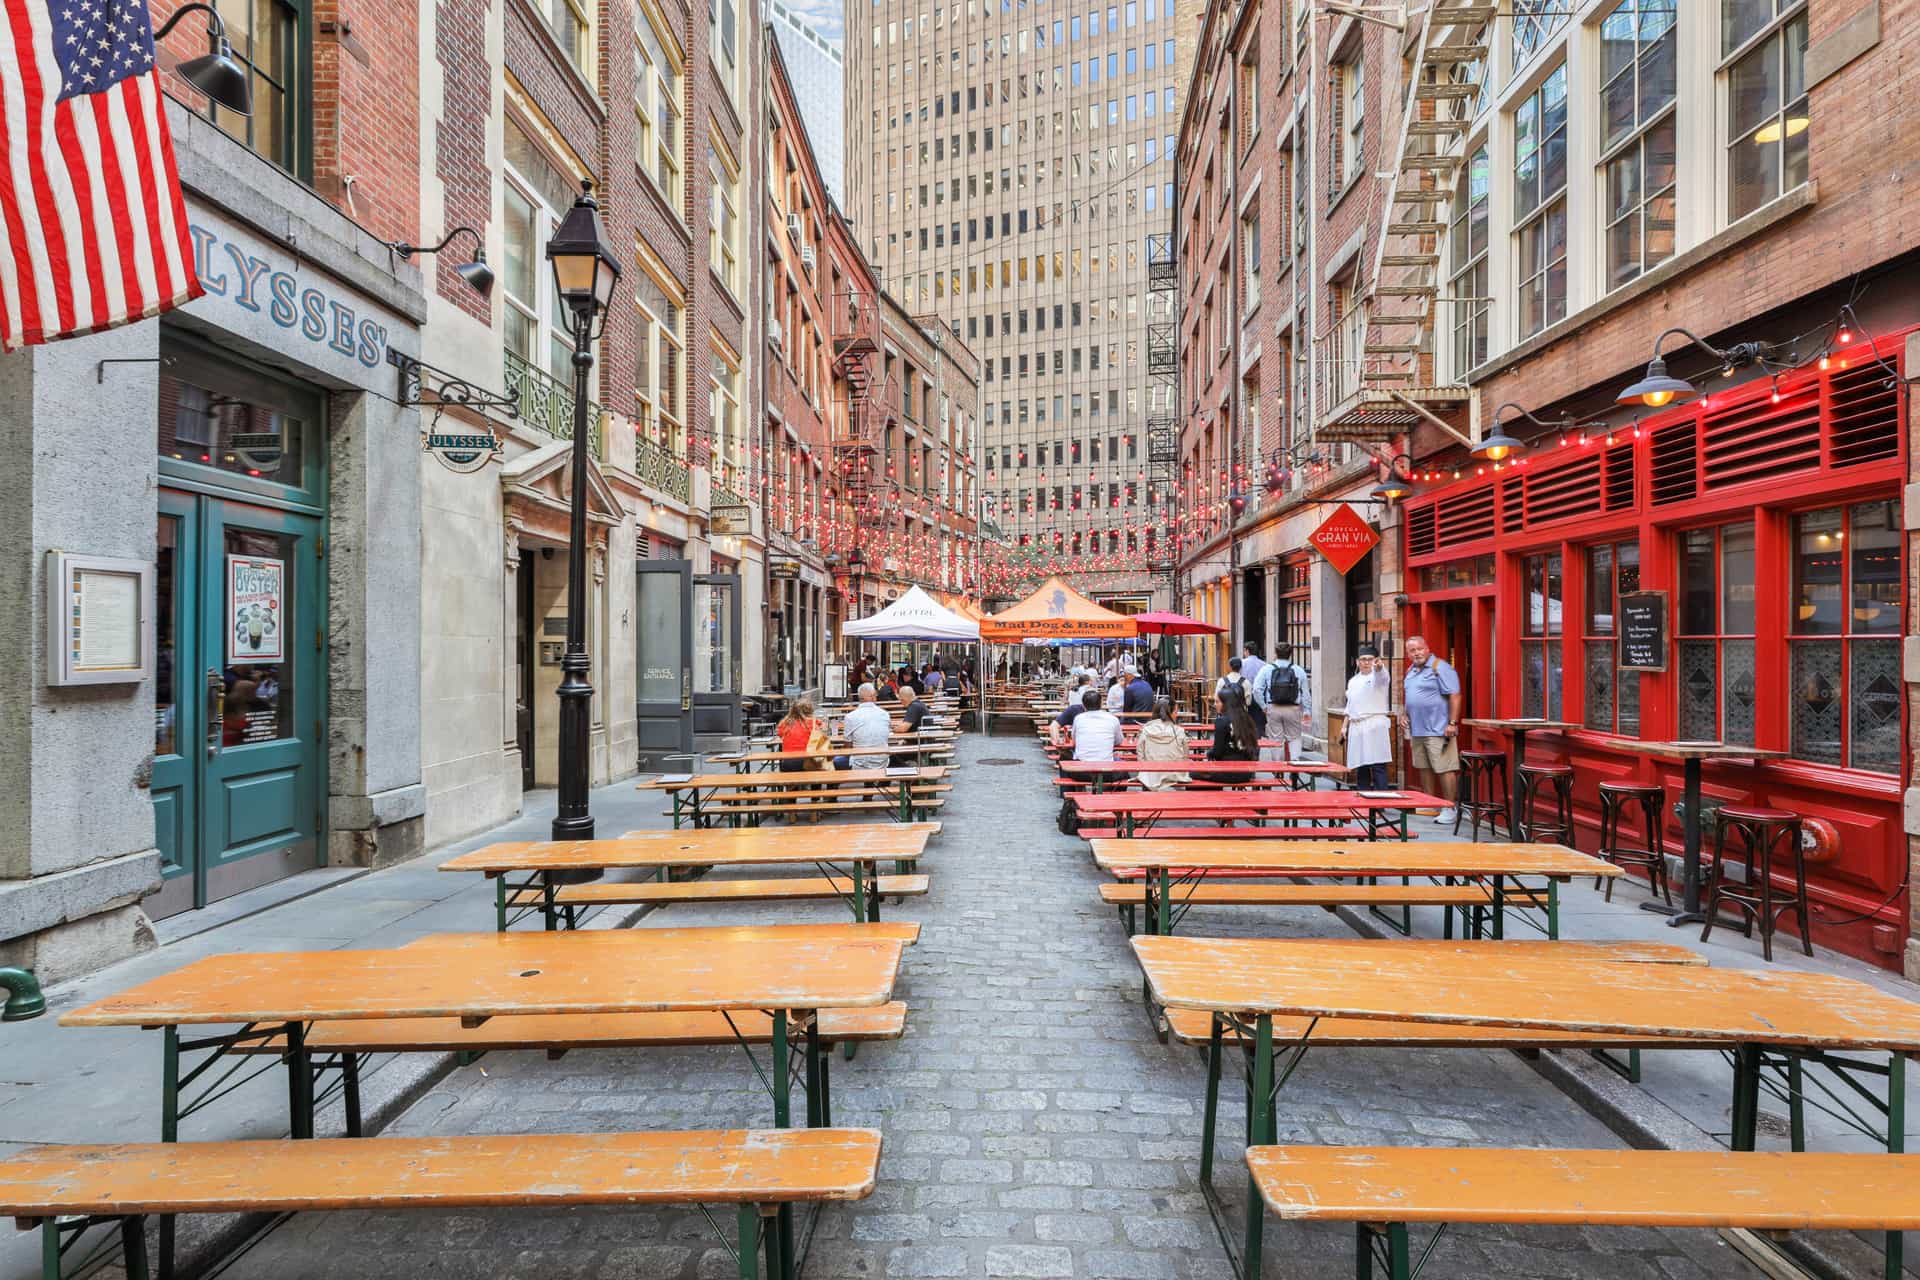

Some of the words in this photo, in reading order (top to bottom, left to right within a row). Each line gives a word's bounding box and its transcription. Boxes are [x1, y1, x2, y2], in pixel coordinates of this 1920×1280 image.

[188, 224, 388, 368] LYSSES'
[1316, 532, 1349, 543] GRAN
[1352, 532, 1371, 543] VIA
[236, 576, 278, 594] OYSTER
[1030, 621, 1059, 630] Dog
[1077, 621, 1124, 629] Beans
